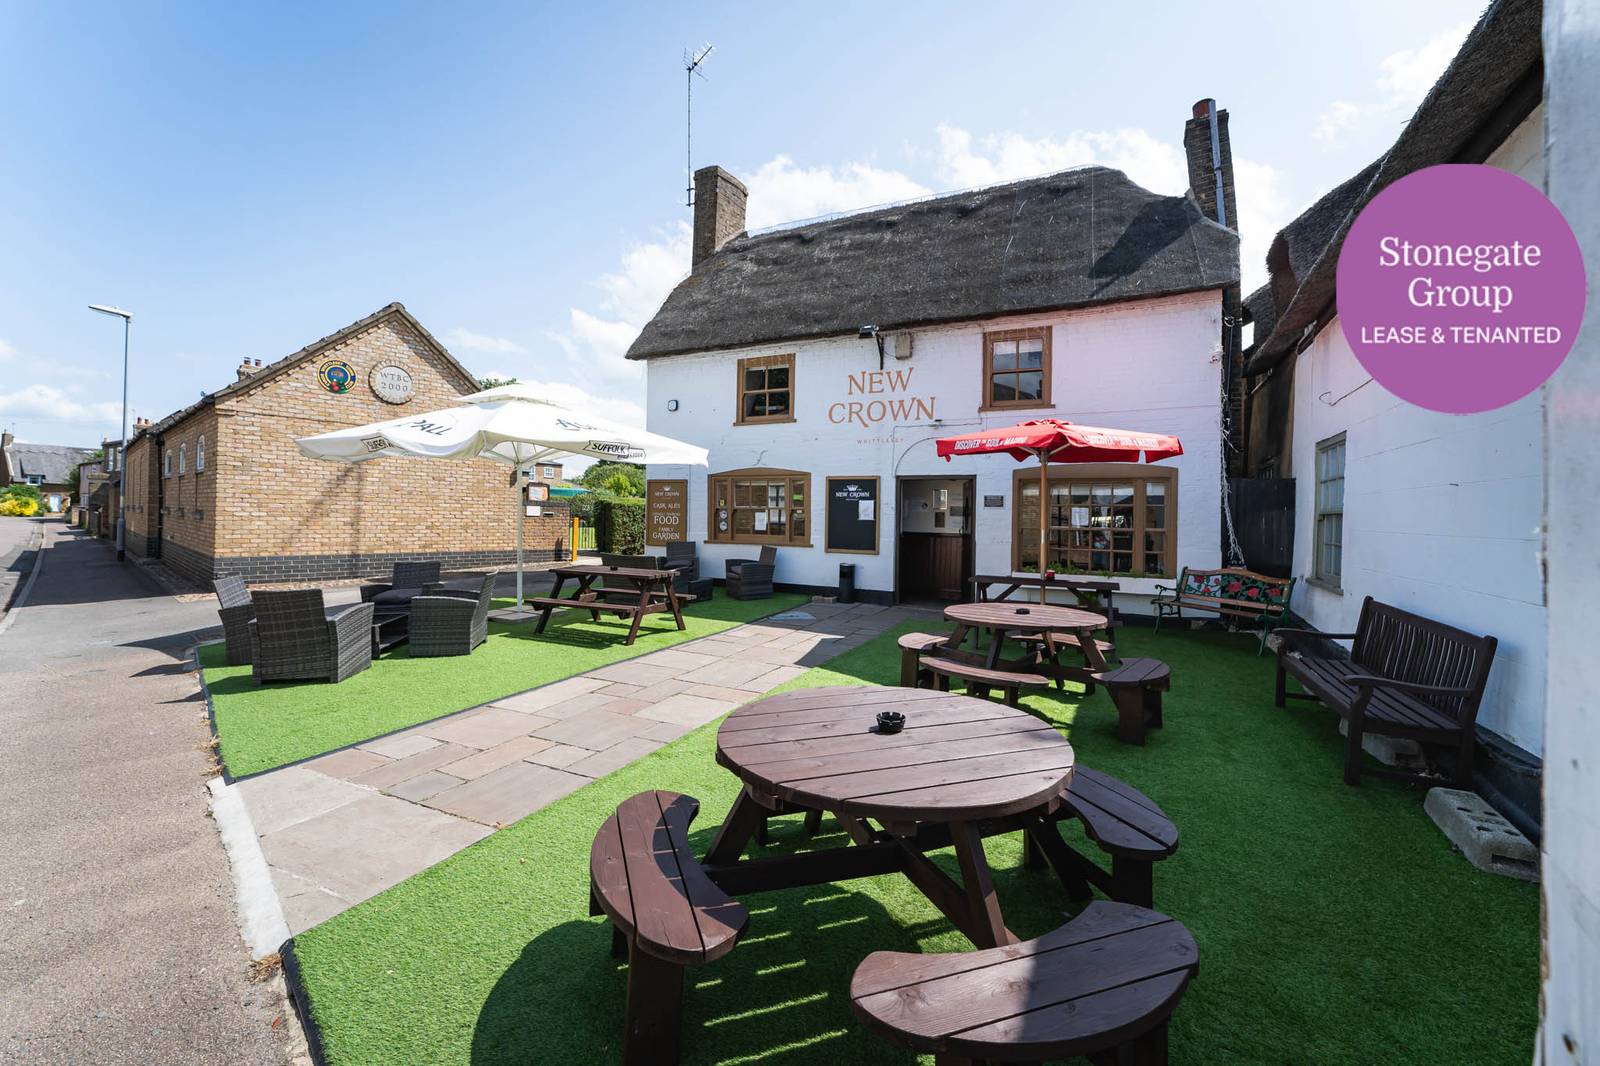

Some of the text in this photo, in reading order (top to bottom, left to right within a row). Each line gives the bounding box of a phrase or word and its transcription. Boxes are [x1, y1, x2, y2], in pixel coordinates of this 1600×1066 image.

[380, 371, 409, 383] WTBC
[847, 367, 914, 395] NEW
[381, 382, 408, 392] 2000
[828, 396, 936, 428] CROWN
[591, 442, 626, 455] SUFFOLK
[849, 491, 870, 499] CROWN
[654, 516, 678, 524] FOOD
[652, 532, 680, 540] GARDEN
